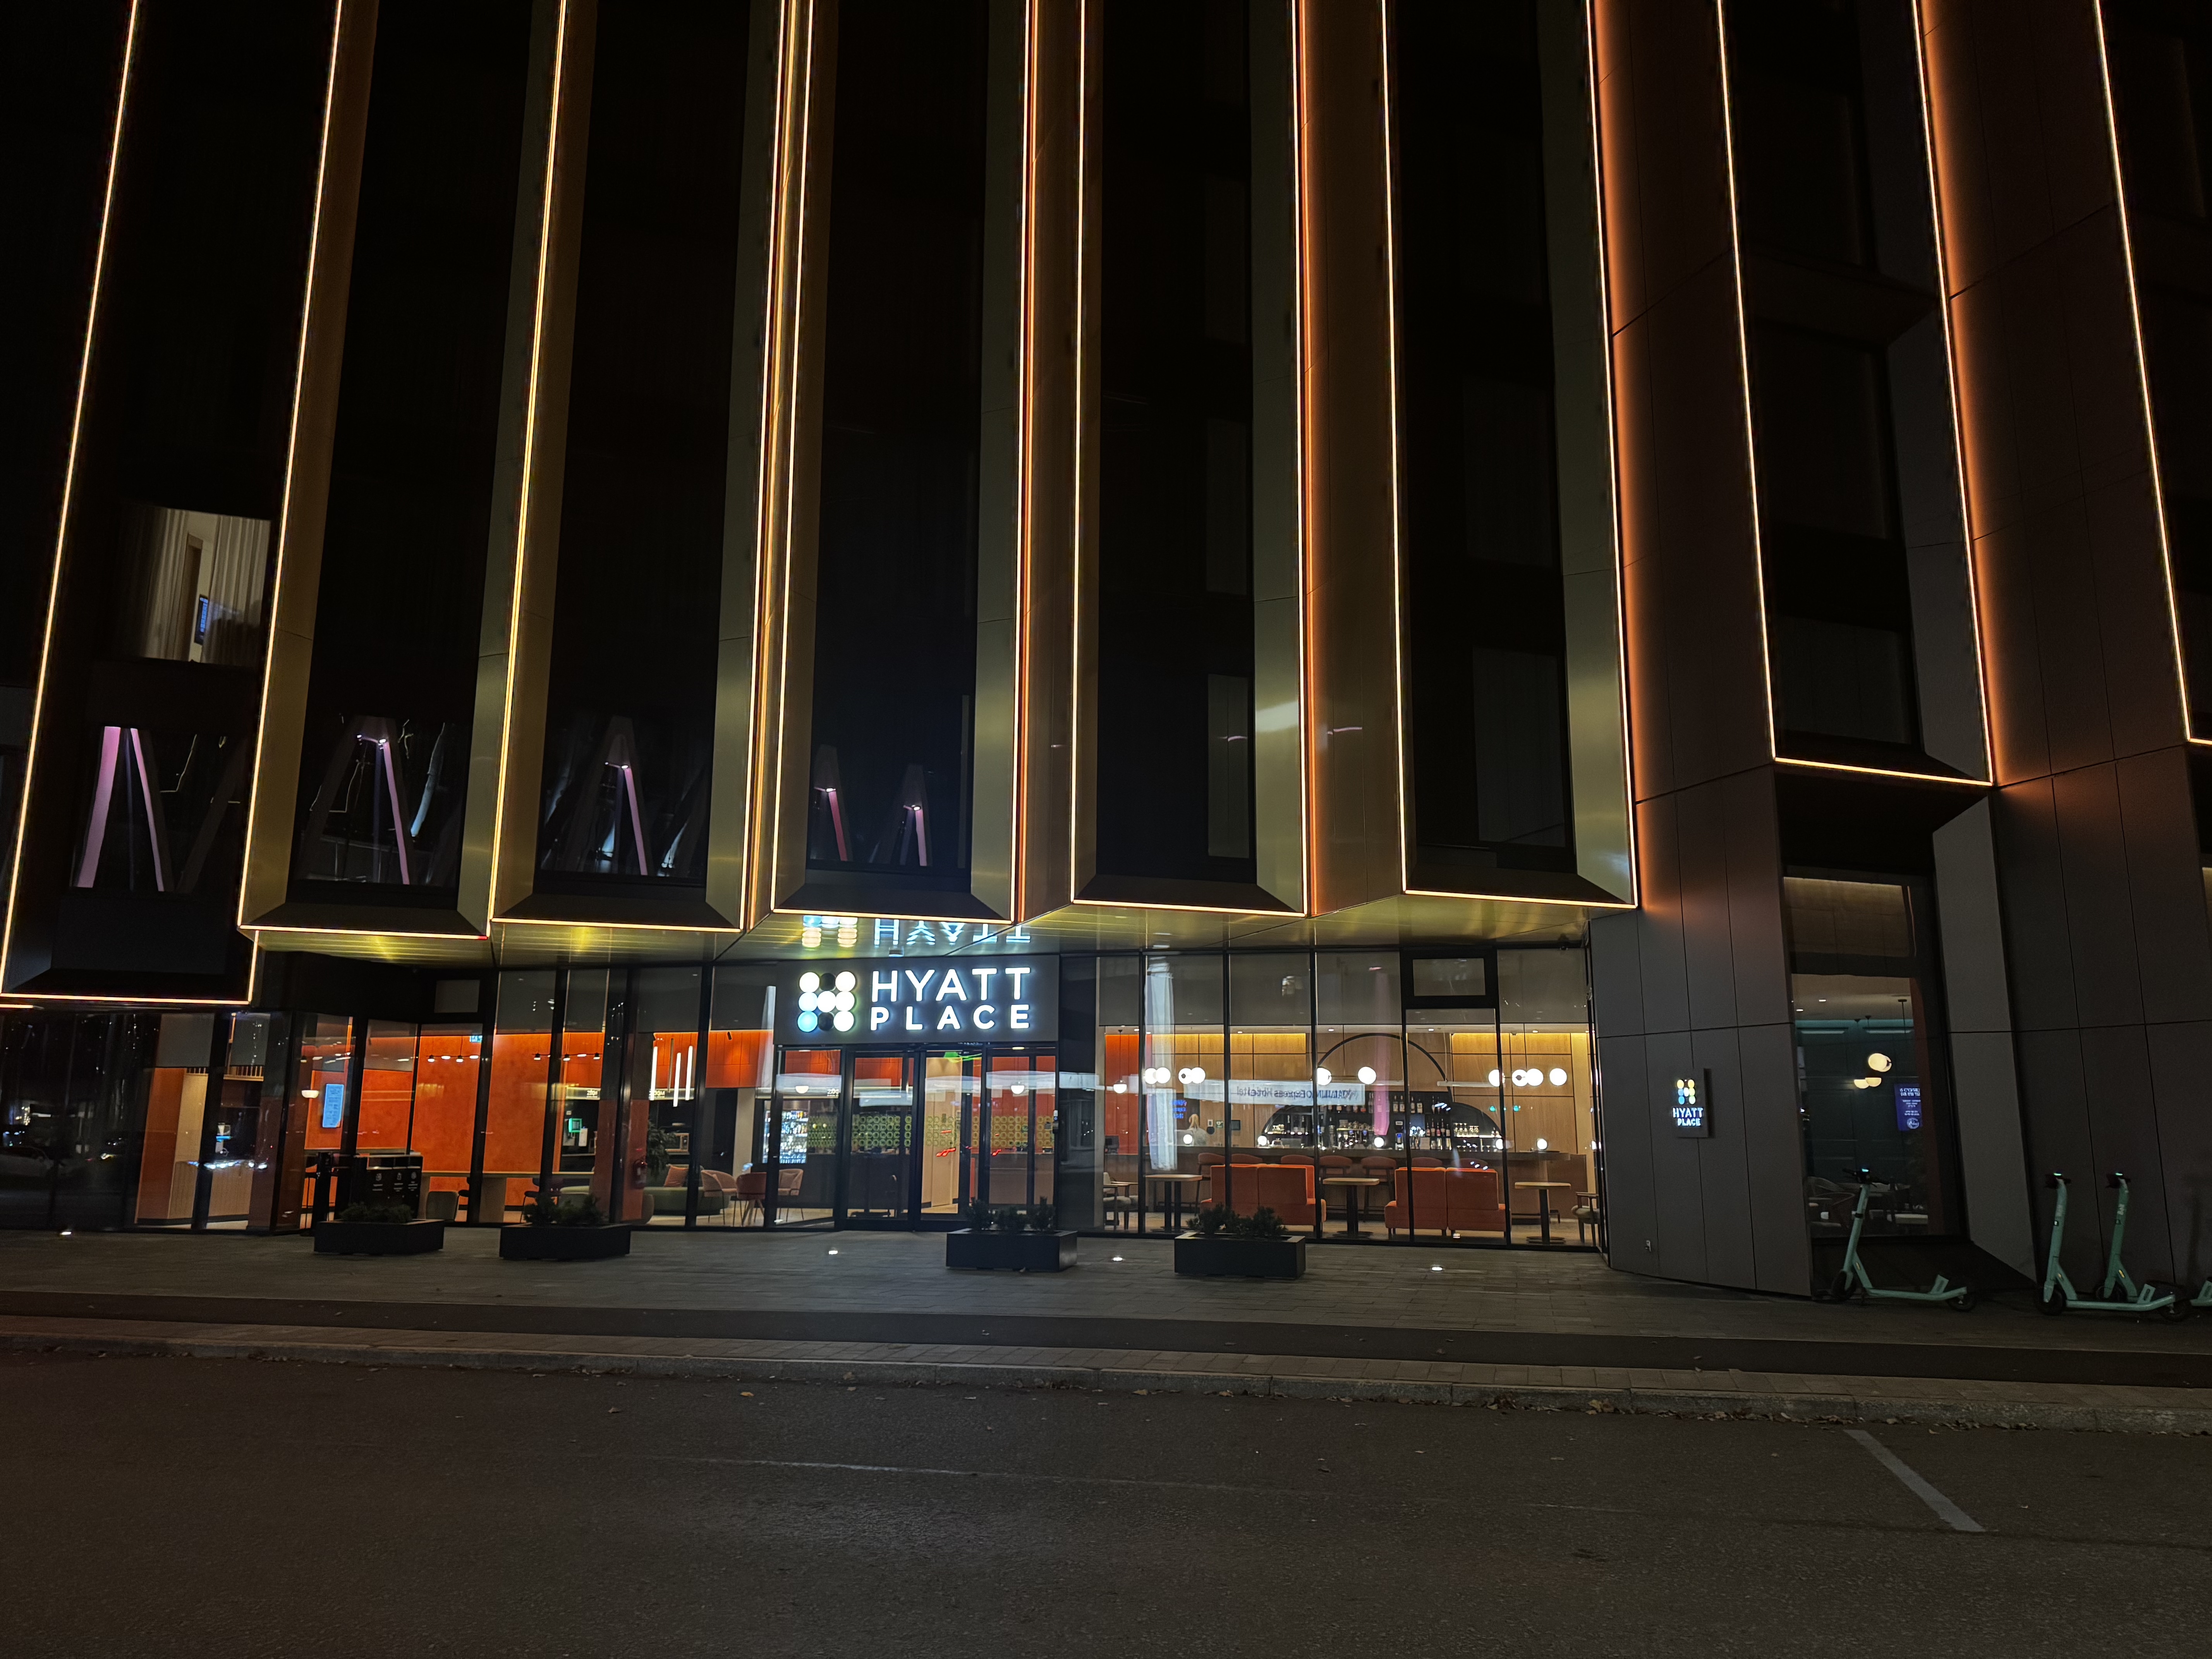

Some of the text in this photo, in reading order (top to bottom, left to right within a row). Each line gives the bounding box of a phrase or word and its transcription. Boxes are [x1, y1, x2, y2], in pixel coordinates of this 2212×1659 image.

[871, 967, 1030, 1002] HYATT
[870, 1005, 1030, 1031] PLACE
[1673, 1108, 1703, 1118] HYATT
[1678, 1118, 1701, 1126] PLACE
